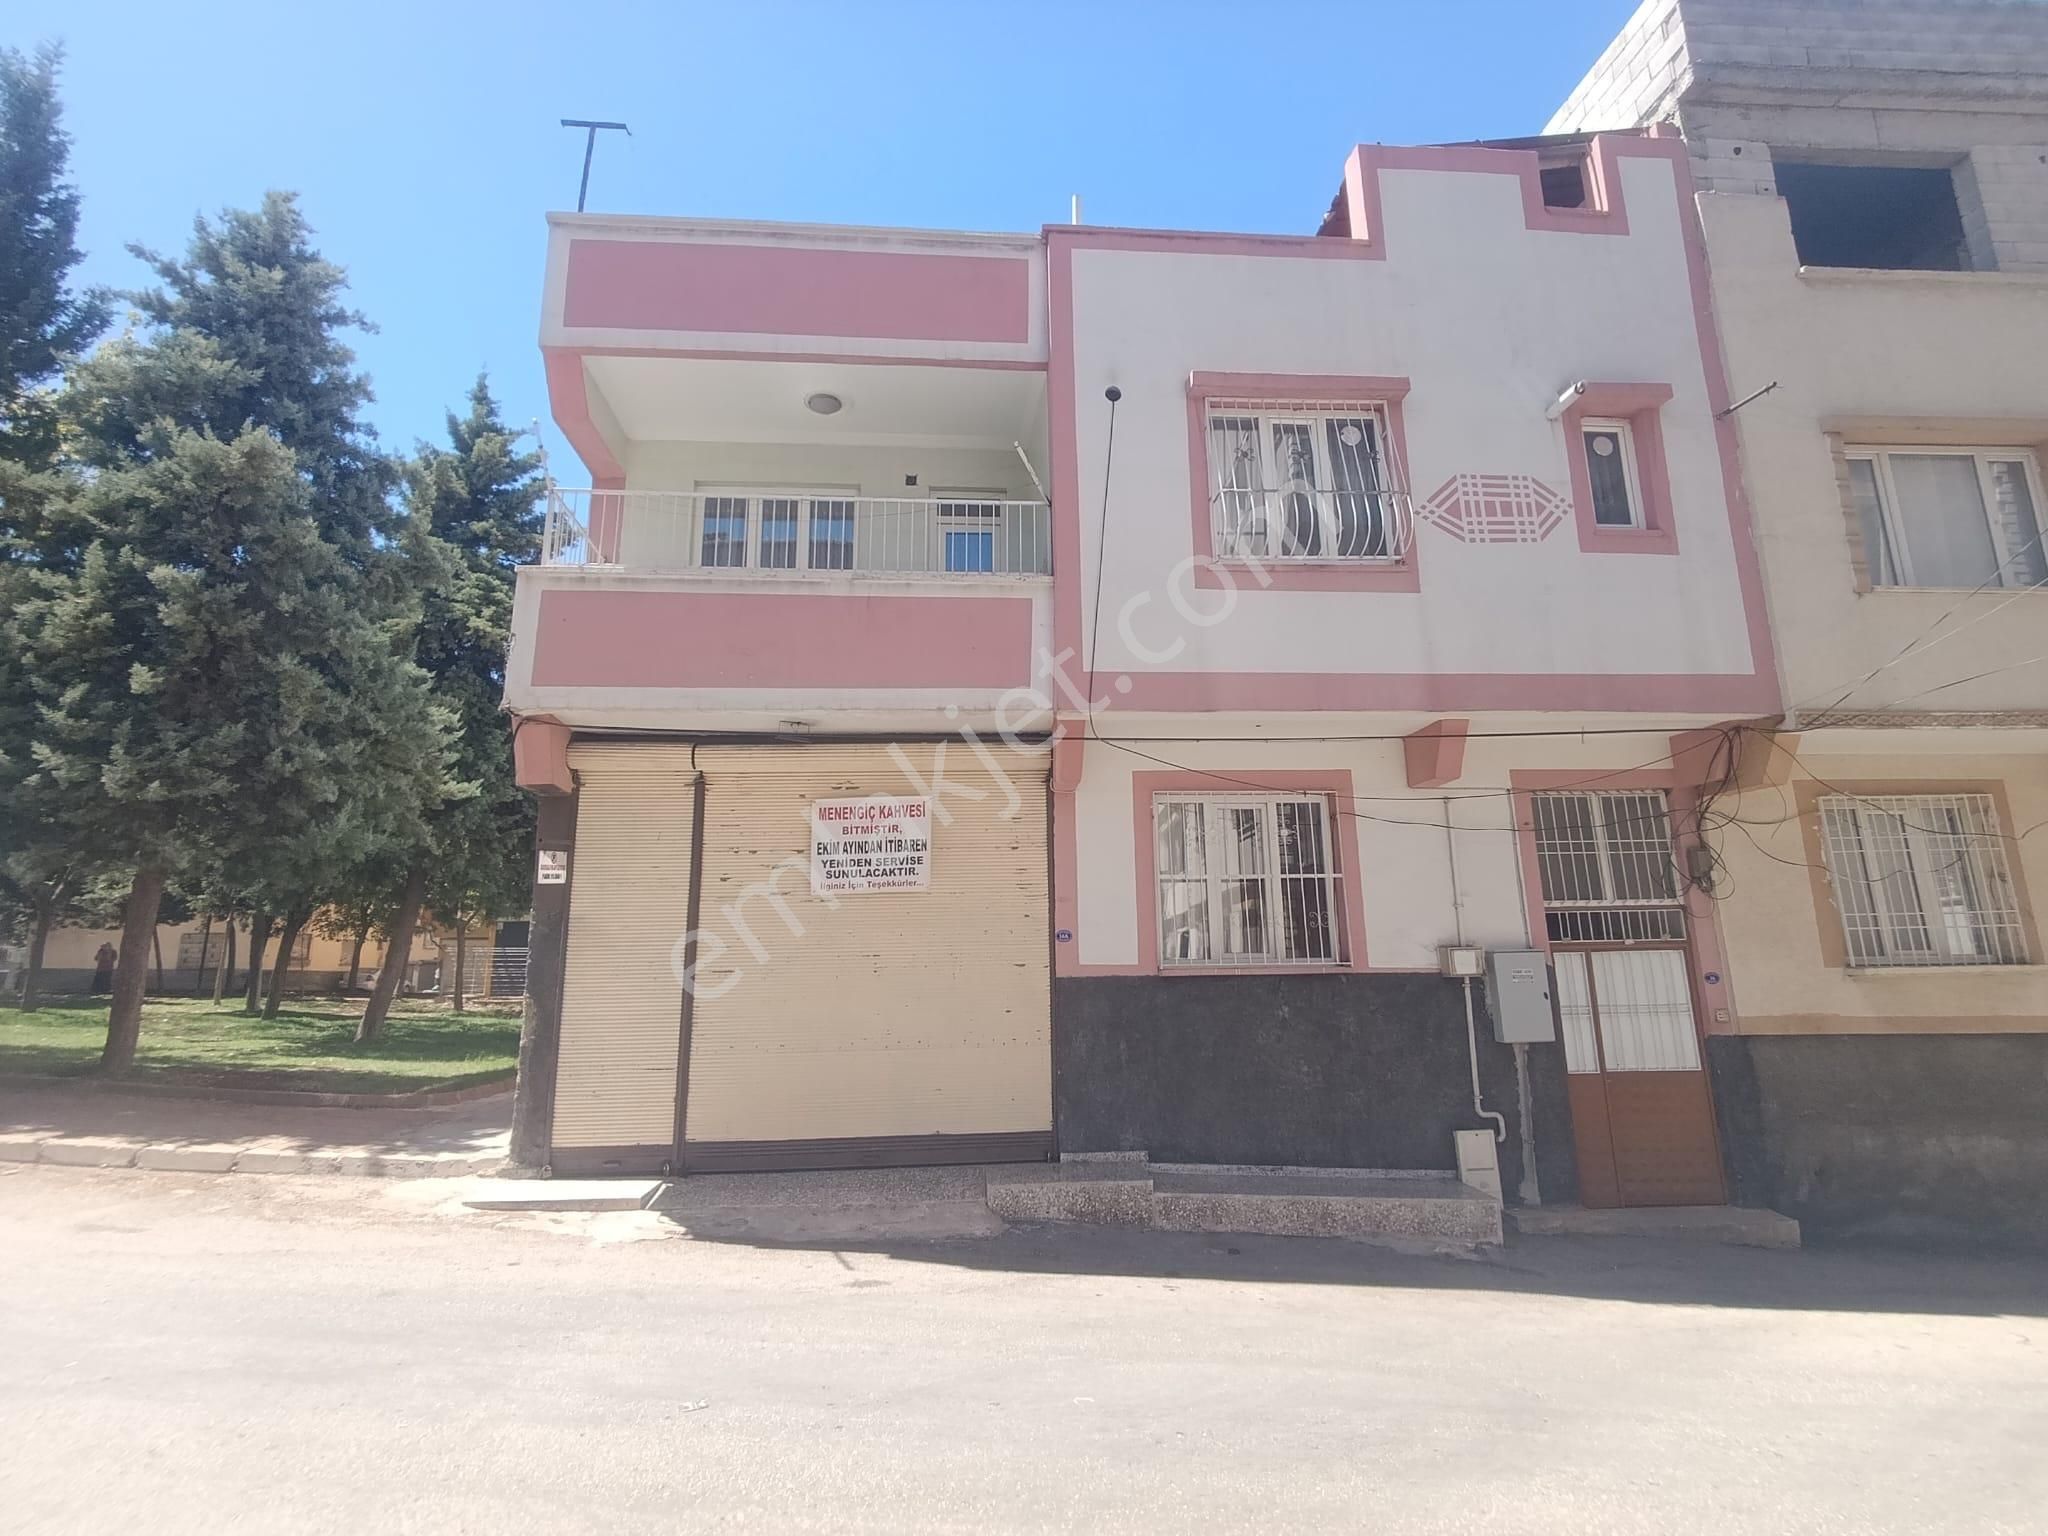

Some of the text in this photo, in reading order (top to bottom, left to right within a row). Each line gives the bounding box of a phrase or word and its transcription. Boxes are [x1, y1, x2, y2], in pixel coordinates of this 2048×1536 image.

[818, 801, 926, 822] MENENGİÇ KAHVESİ
[816, 836, 928, 856] EKİM AYINDAN İTİBAREN
[821, 855, 924, 869] YENİDEN SERVİSE
[825, 867, 920, 879] SUNULACAKTIR.
